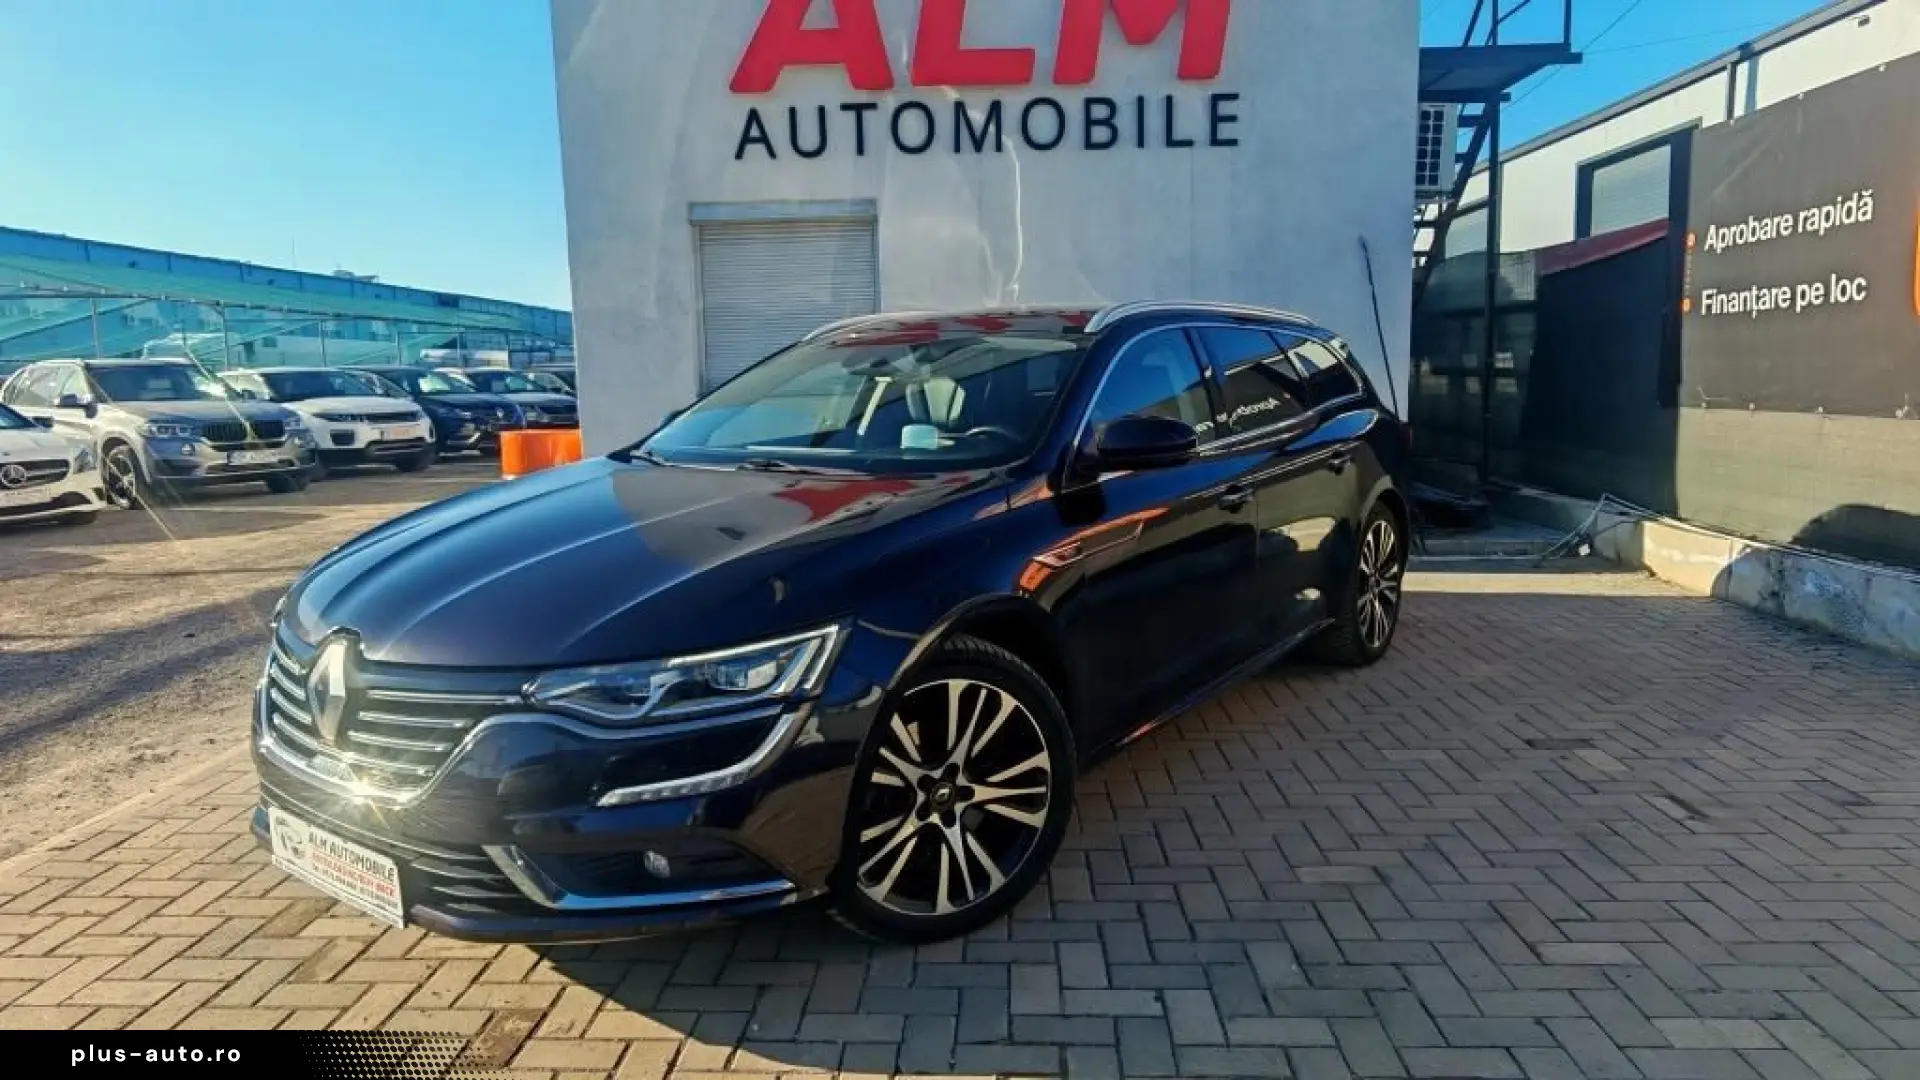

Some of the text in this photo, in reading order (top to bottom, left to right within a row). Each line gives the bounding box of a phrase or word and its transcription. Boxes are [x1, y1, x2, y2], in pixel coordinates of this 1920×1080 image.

[729, 0, 1231, 93] ALM
[734, 92, 1241, 160] AUTOMOBILE
[1703, 188, 1875, 254] Aprobare rapidă
[1701, 273, 1868, 319] Finanțare pe loc
